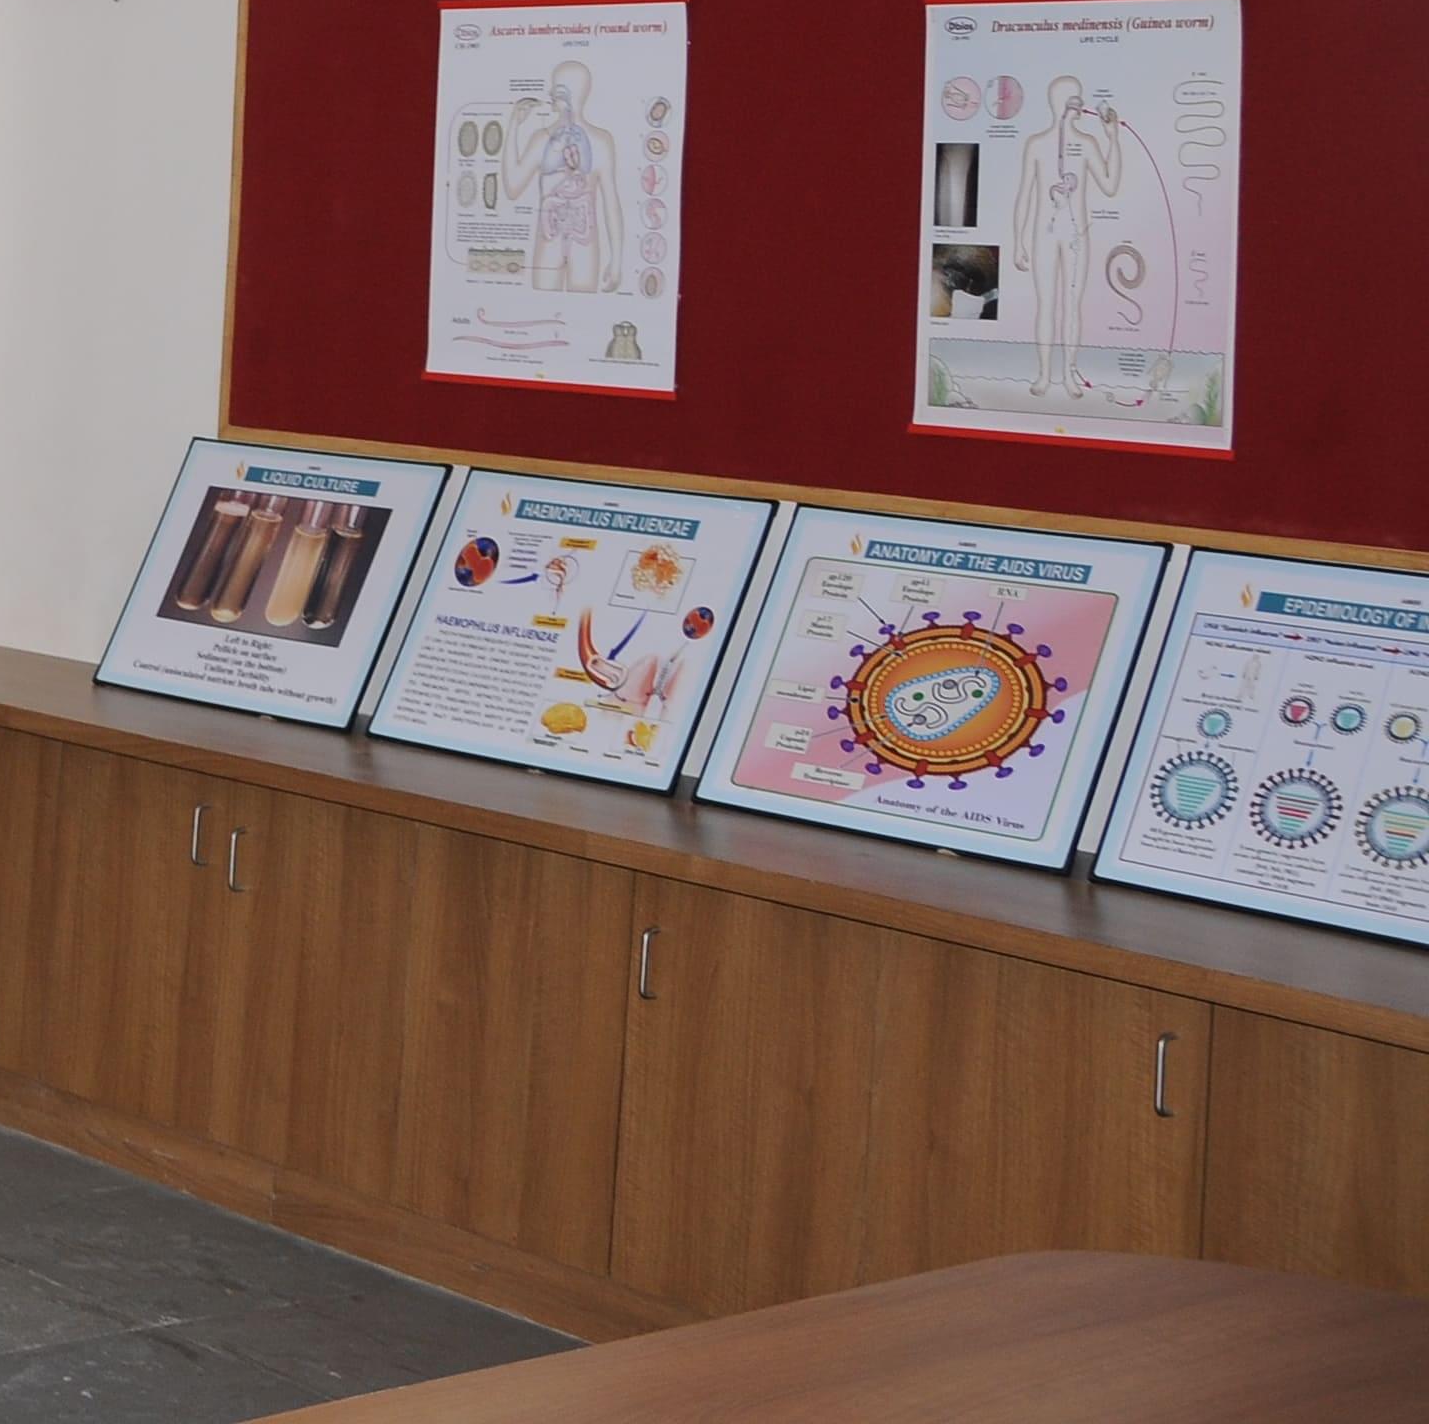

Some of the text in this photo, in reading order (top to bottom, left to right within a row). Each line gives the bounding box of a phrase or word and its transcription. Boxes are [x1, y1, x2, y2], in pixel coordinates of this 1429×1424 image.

[991, 14, 1215, 33] Dracunculus medinensis (Guinea worm)
[261, 471, 359, 493] LIQUID CULTURE
[521, 502, 692, 537] HAEMOPHILUS INFLUENZAE
[869, 543, 1086, 581] ANATOMY OF THE AIDS VIRUS
[1283, 597, 1393, 626] EPIDEMIOLOGY
[1394, 612, 1418, 628] OF
[435, 614, 560, 643] HAEMOPHILUS INFLUENZAE
[876, 795, 1025, 829] Anatomy of the AIDS Virus
